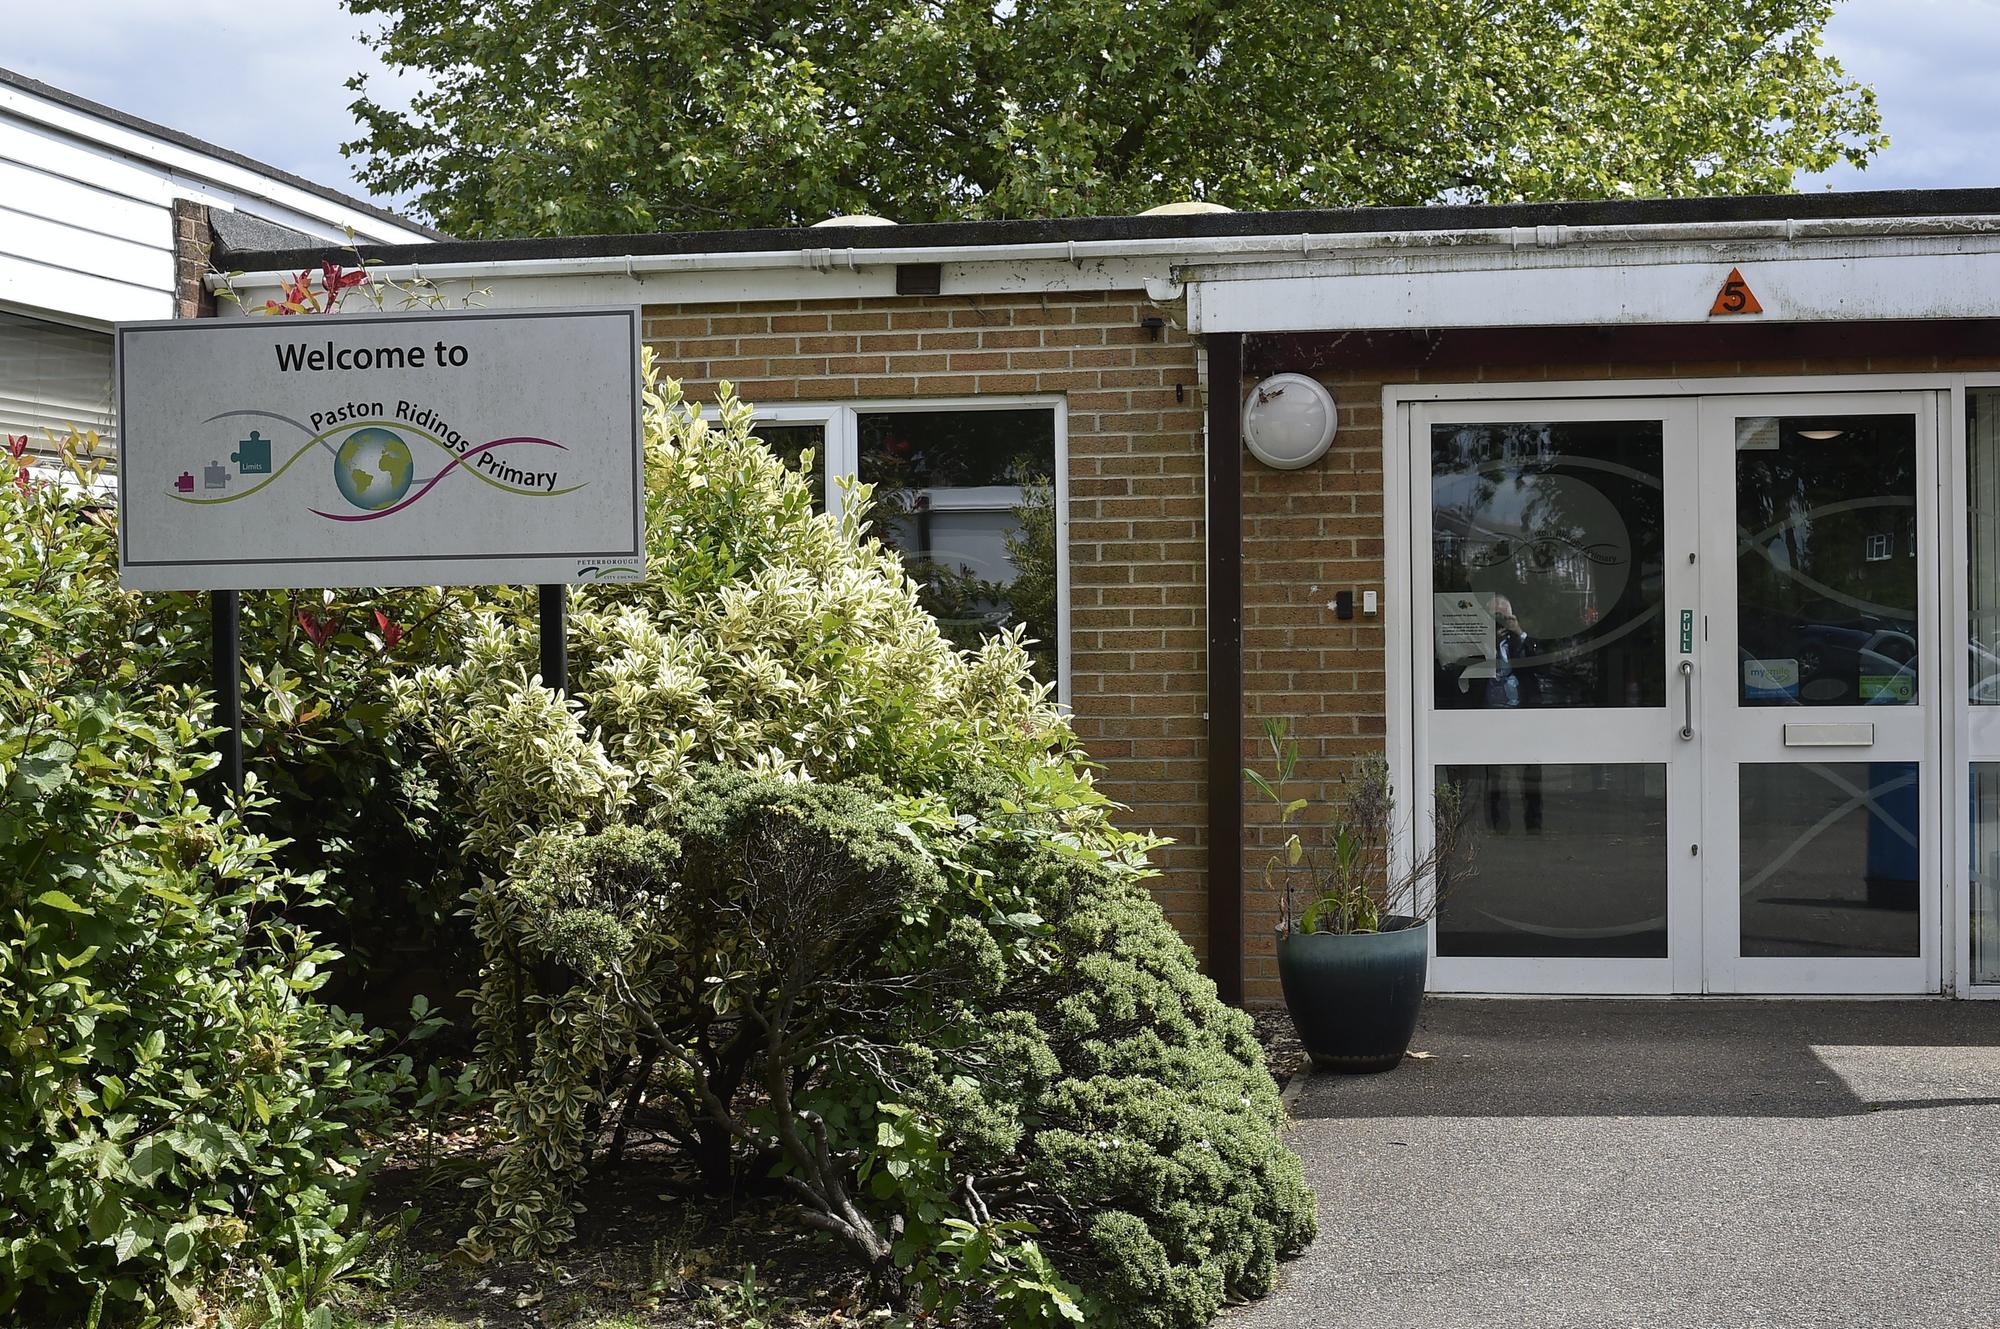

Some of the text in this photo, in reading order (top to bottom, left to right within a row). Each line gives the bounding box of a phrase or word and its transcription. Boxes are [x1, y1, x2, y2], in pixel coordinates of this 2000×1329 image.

[1723, 281, 1746, 312] 5
[275, 341, 469, 372] Welcome to
[310, 400, 558, 492] Paston Ridings Primary
[242, 463, 263, 471] Limits
[1683, 612, 1691, 652] PULL
[1750, 669, 1766, 678] my
